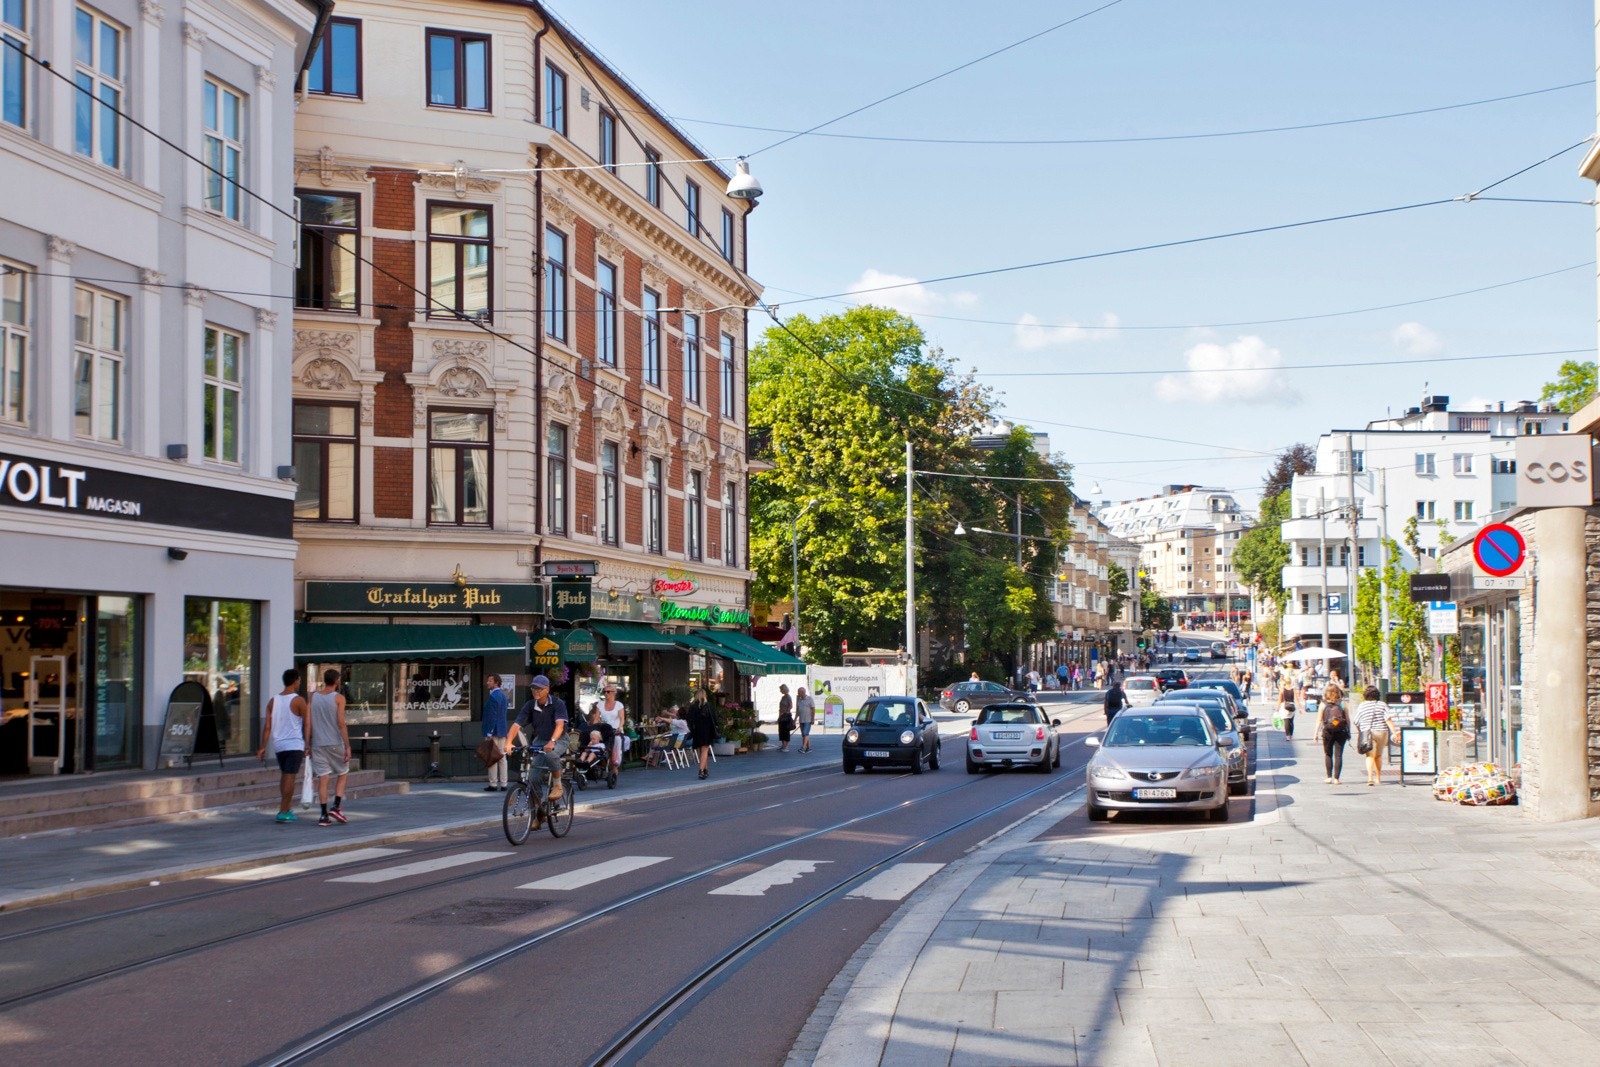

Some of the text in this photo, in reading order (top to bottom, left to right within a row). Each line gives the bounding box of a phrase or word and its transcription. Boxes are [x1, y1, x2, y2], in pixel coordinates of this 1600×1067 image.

[1525, 460, 1587, 484] COS
[86, 496, 141, 516] MAGASIN
[655, 580, 693, 593] Blomster
[1485, 579, 1495, 587] 07
[1507, 579, 1515, 587] 17
[366, 587, 501, 609] Trafalgar Pub
[556, 590, 587, 608] Pub
[1330, 597, 1338, 606] P
[661, 600, 709, 623] Blomster
[535, 656, 559, 665] TOTO
[168, 724, 192, 735] -50%
